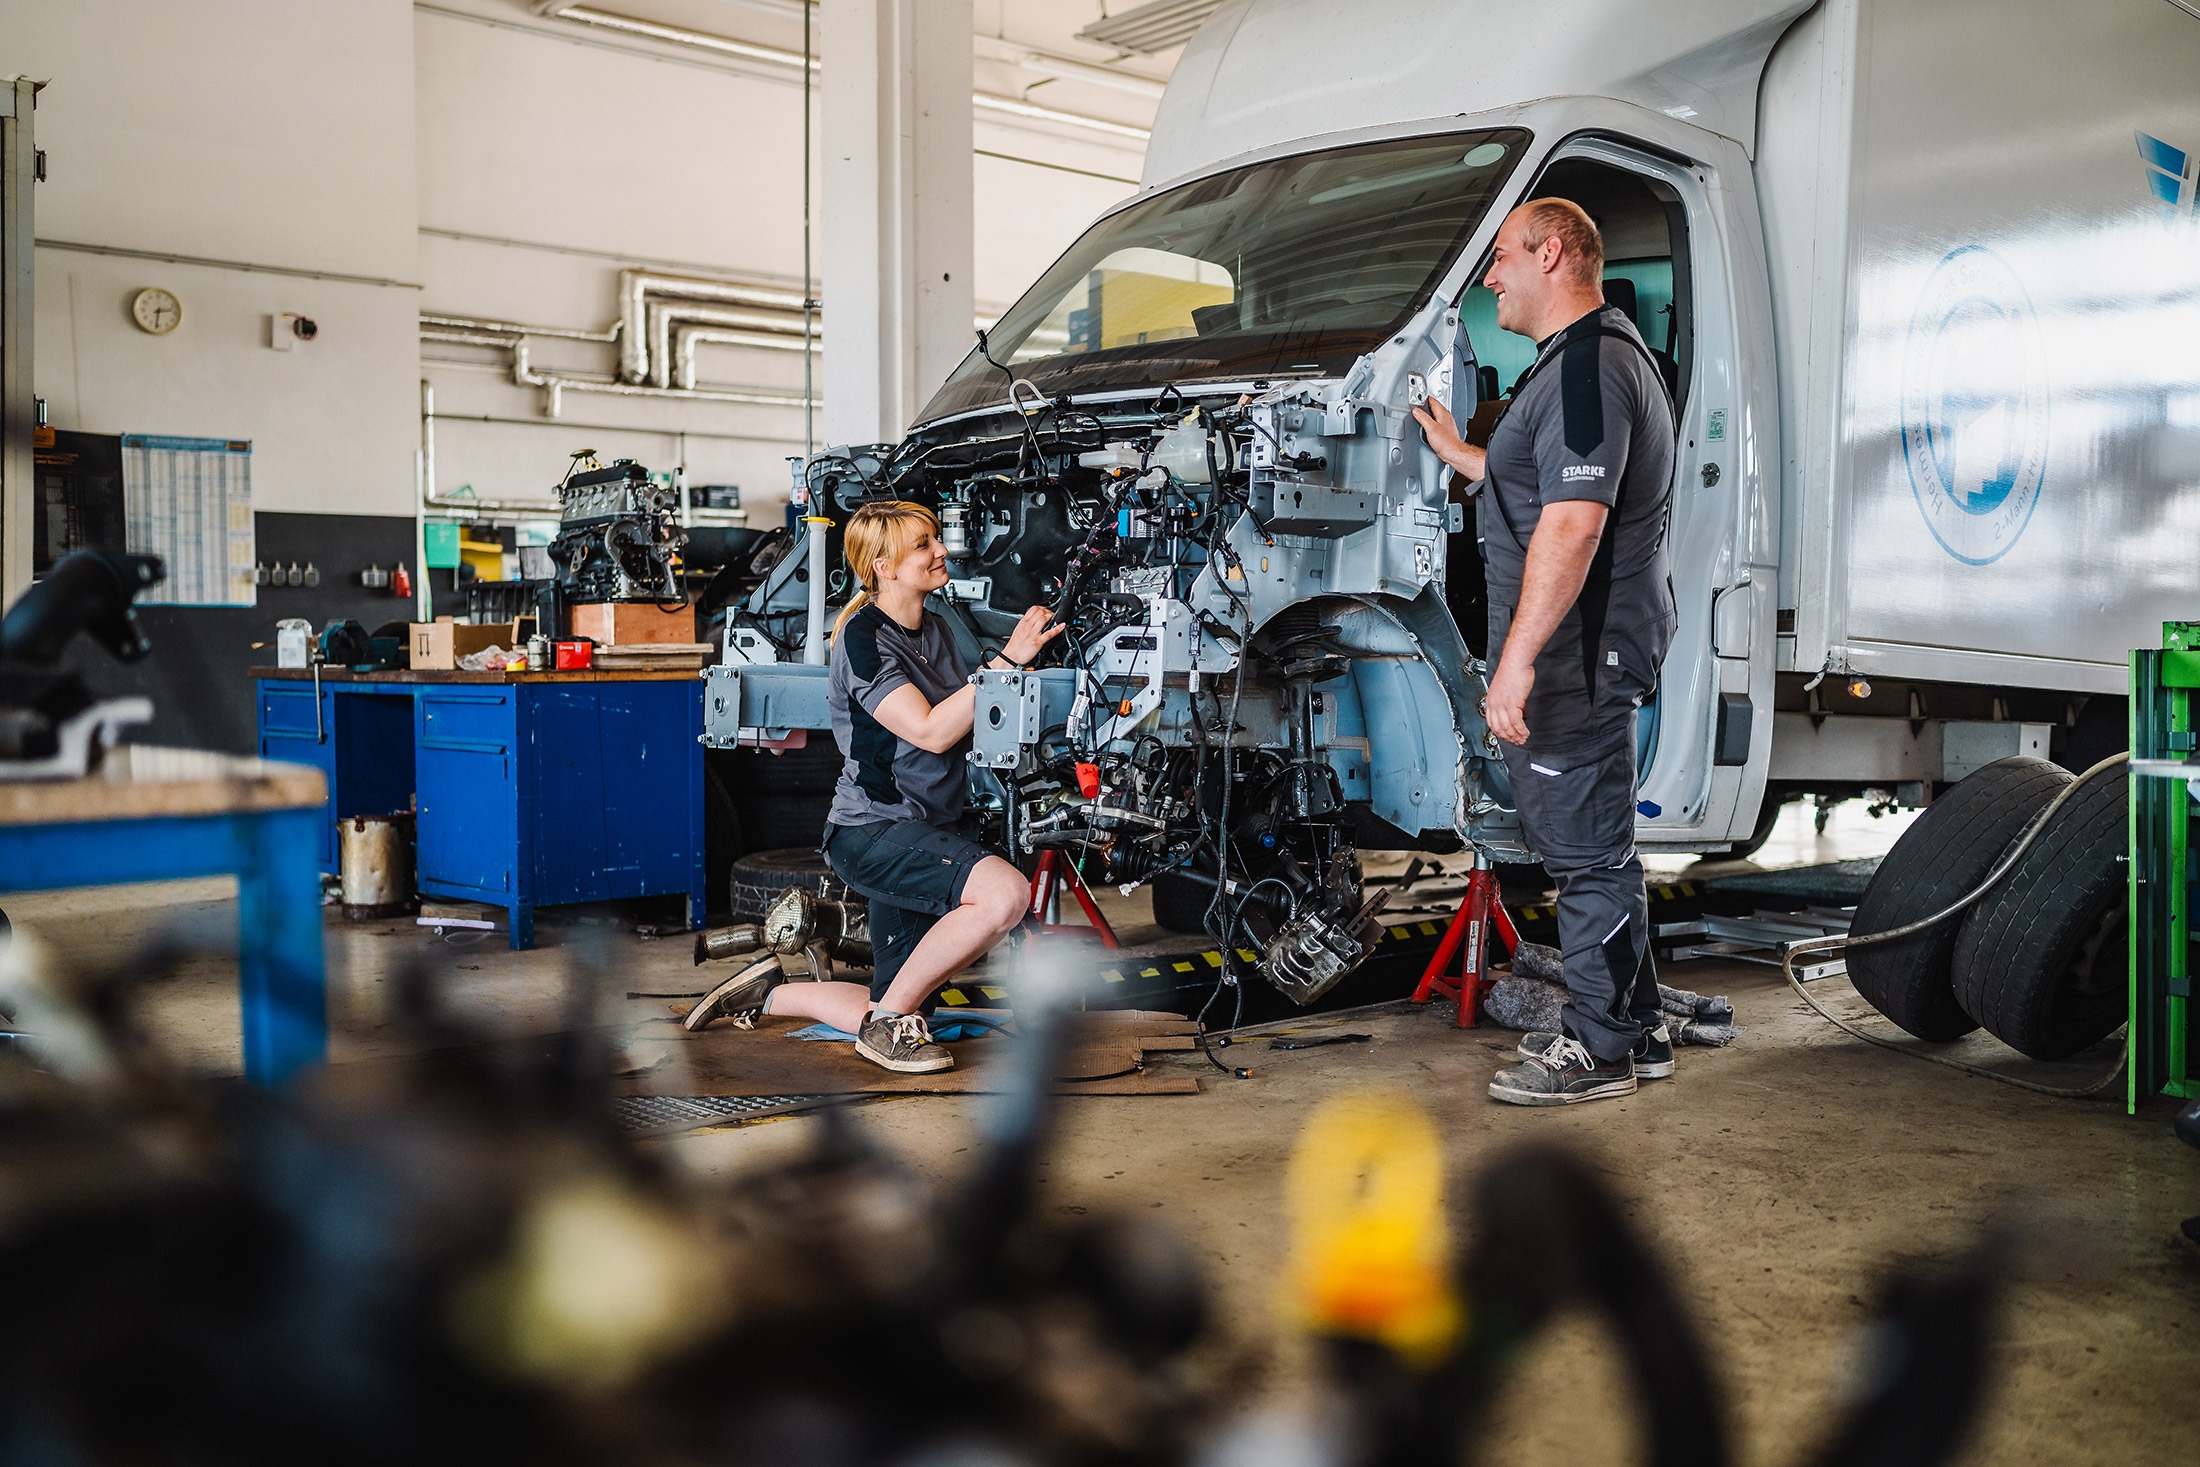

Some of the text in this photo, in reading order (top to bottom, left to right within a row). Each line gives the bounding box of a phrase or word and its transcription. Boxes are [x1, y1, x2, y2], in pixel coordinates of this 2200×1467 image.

[1914, 422, 1942, 516] Hermes
[1960, 265, 2005, 294] Service
[1562, 465, 1605, 477] STARKE
